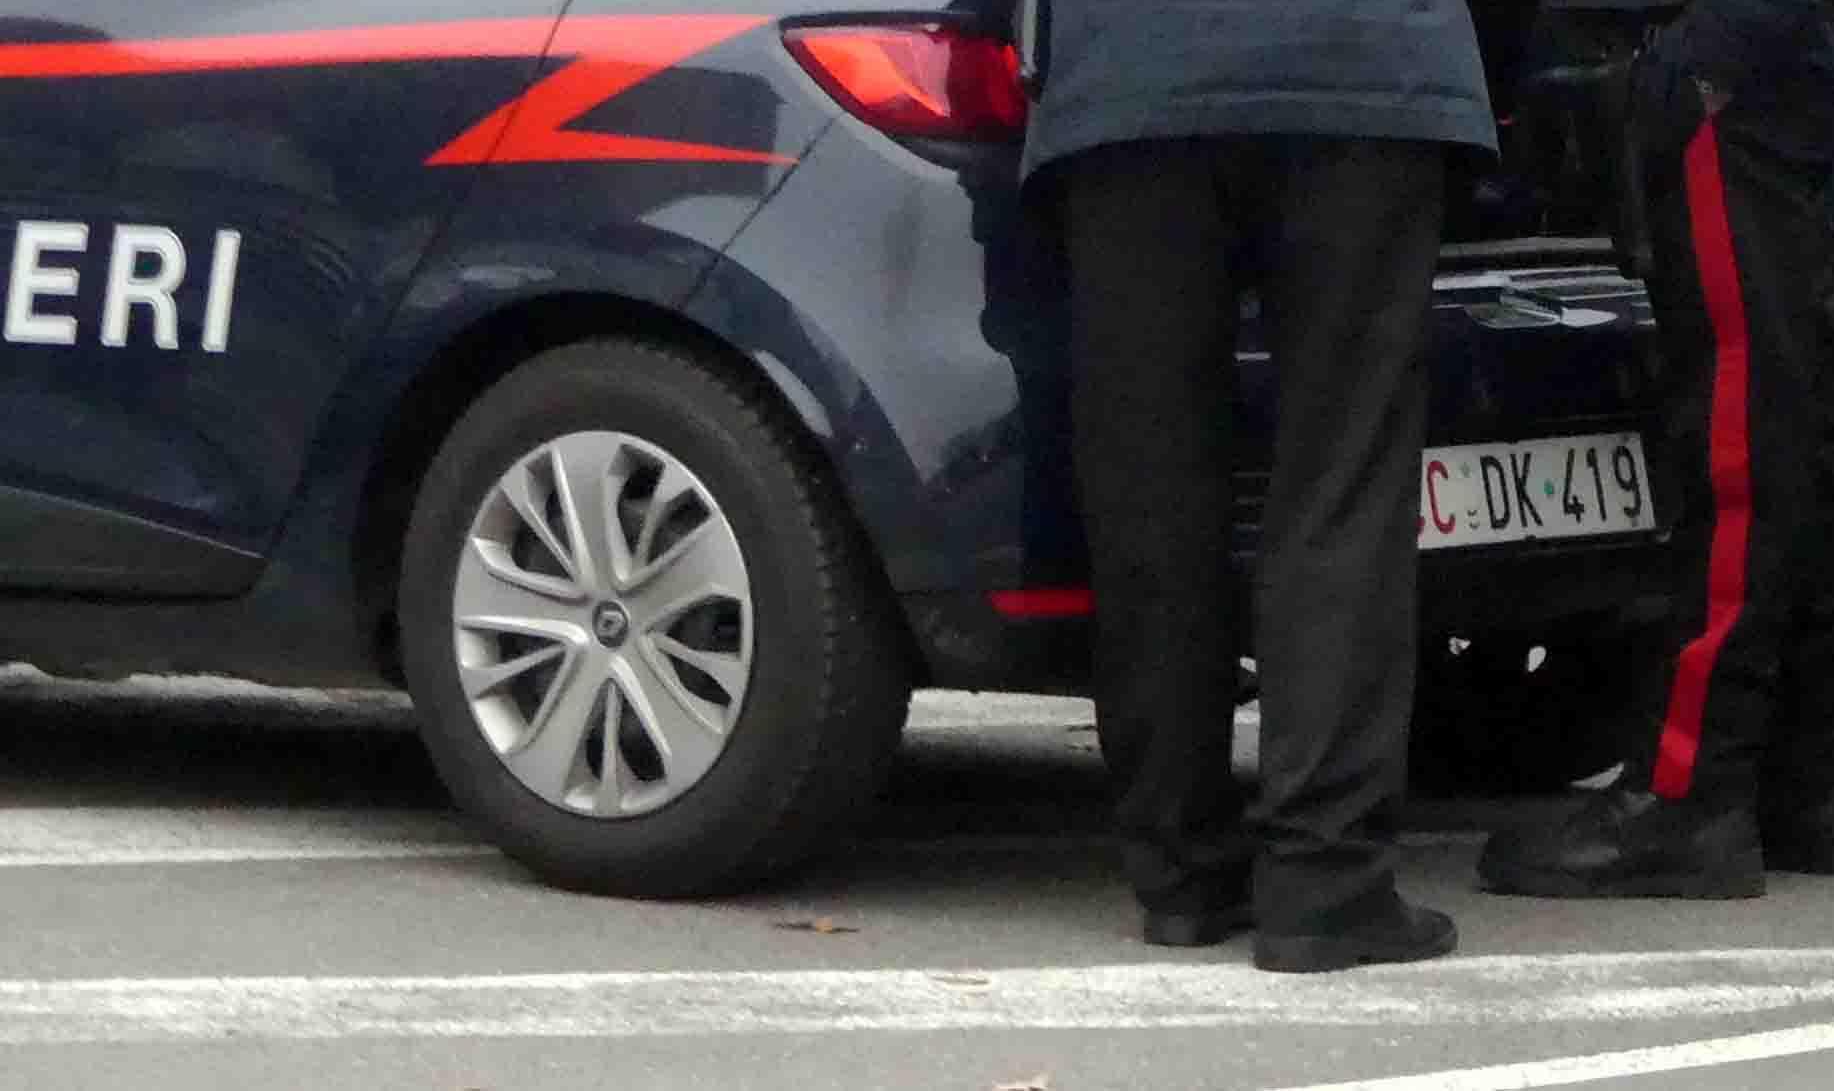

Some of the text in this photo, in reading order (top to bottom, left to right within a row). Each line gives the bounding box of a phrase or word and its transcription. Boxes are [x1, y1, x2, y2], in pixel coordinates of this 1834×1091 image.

[3, 219, 242, 353] ERI
[1416, 444, 1642, 535] C DK 419
